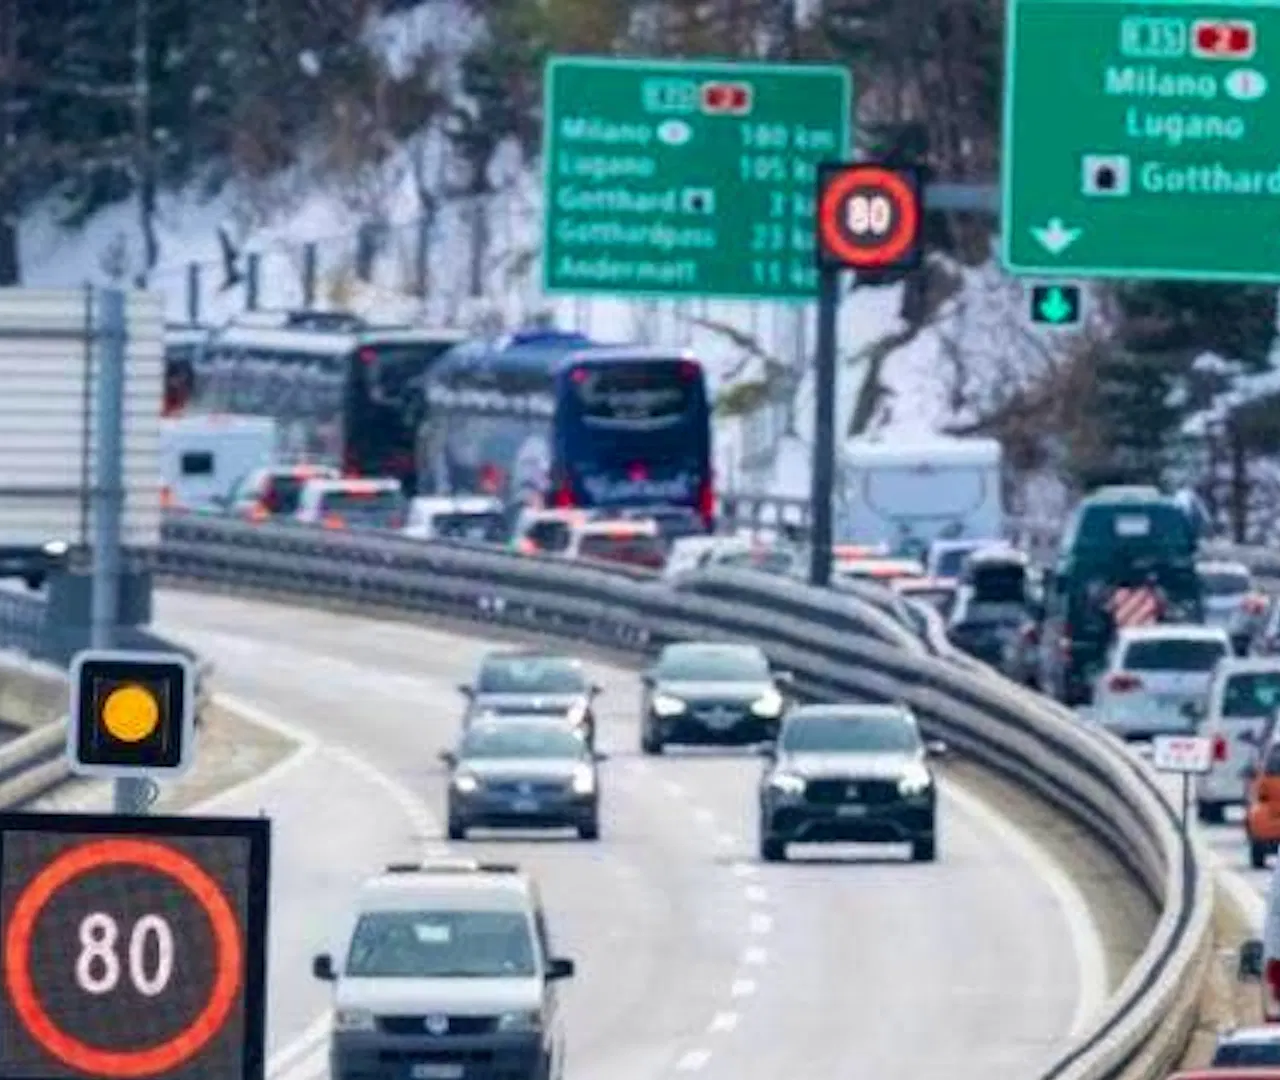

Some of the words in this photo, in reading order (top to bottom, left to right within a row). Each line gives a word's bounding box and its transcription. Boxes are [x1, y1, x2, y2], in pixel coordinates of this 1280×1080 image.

[1104, 64, 1218, 99] Milano
[560, 116, 652, 145] Milano
[740, 122, 788, 148] 180
[792, 124, 834, 148] km
[1126, 104, 1245, 146] Lugano
[558, 150, 656, 181] Lugano
[740, 154, 787, 182] 105
[557, 186, 678, 213] Gotthard
[845, 195, 891, 234] 80
[555, 219, 716, 250] Gotthardpass
[556, 255, 697, 283] Andermatt
[752, 260, 782, 286] 11
[76, 912, 174, 997] 80
